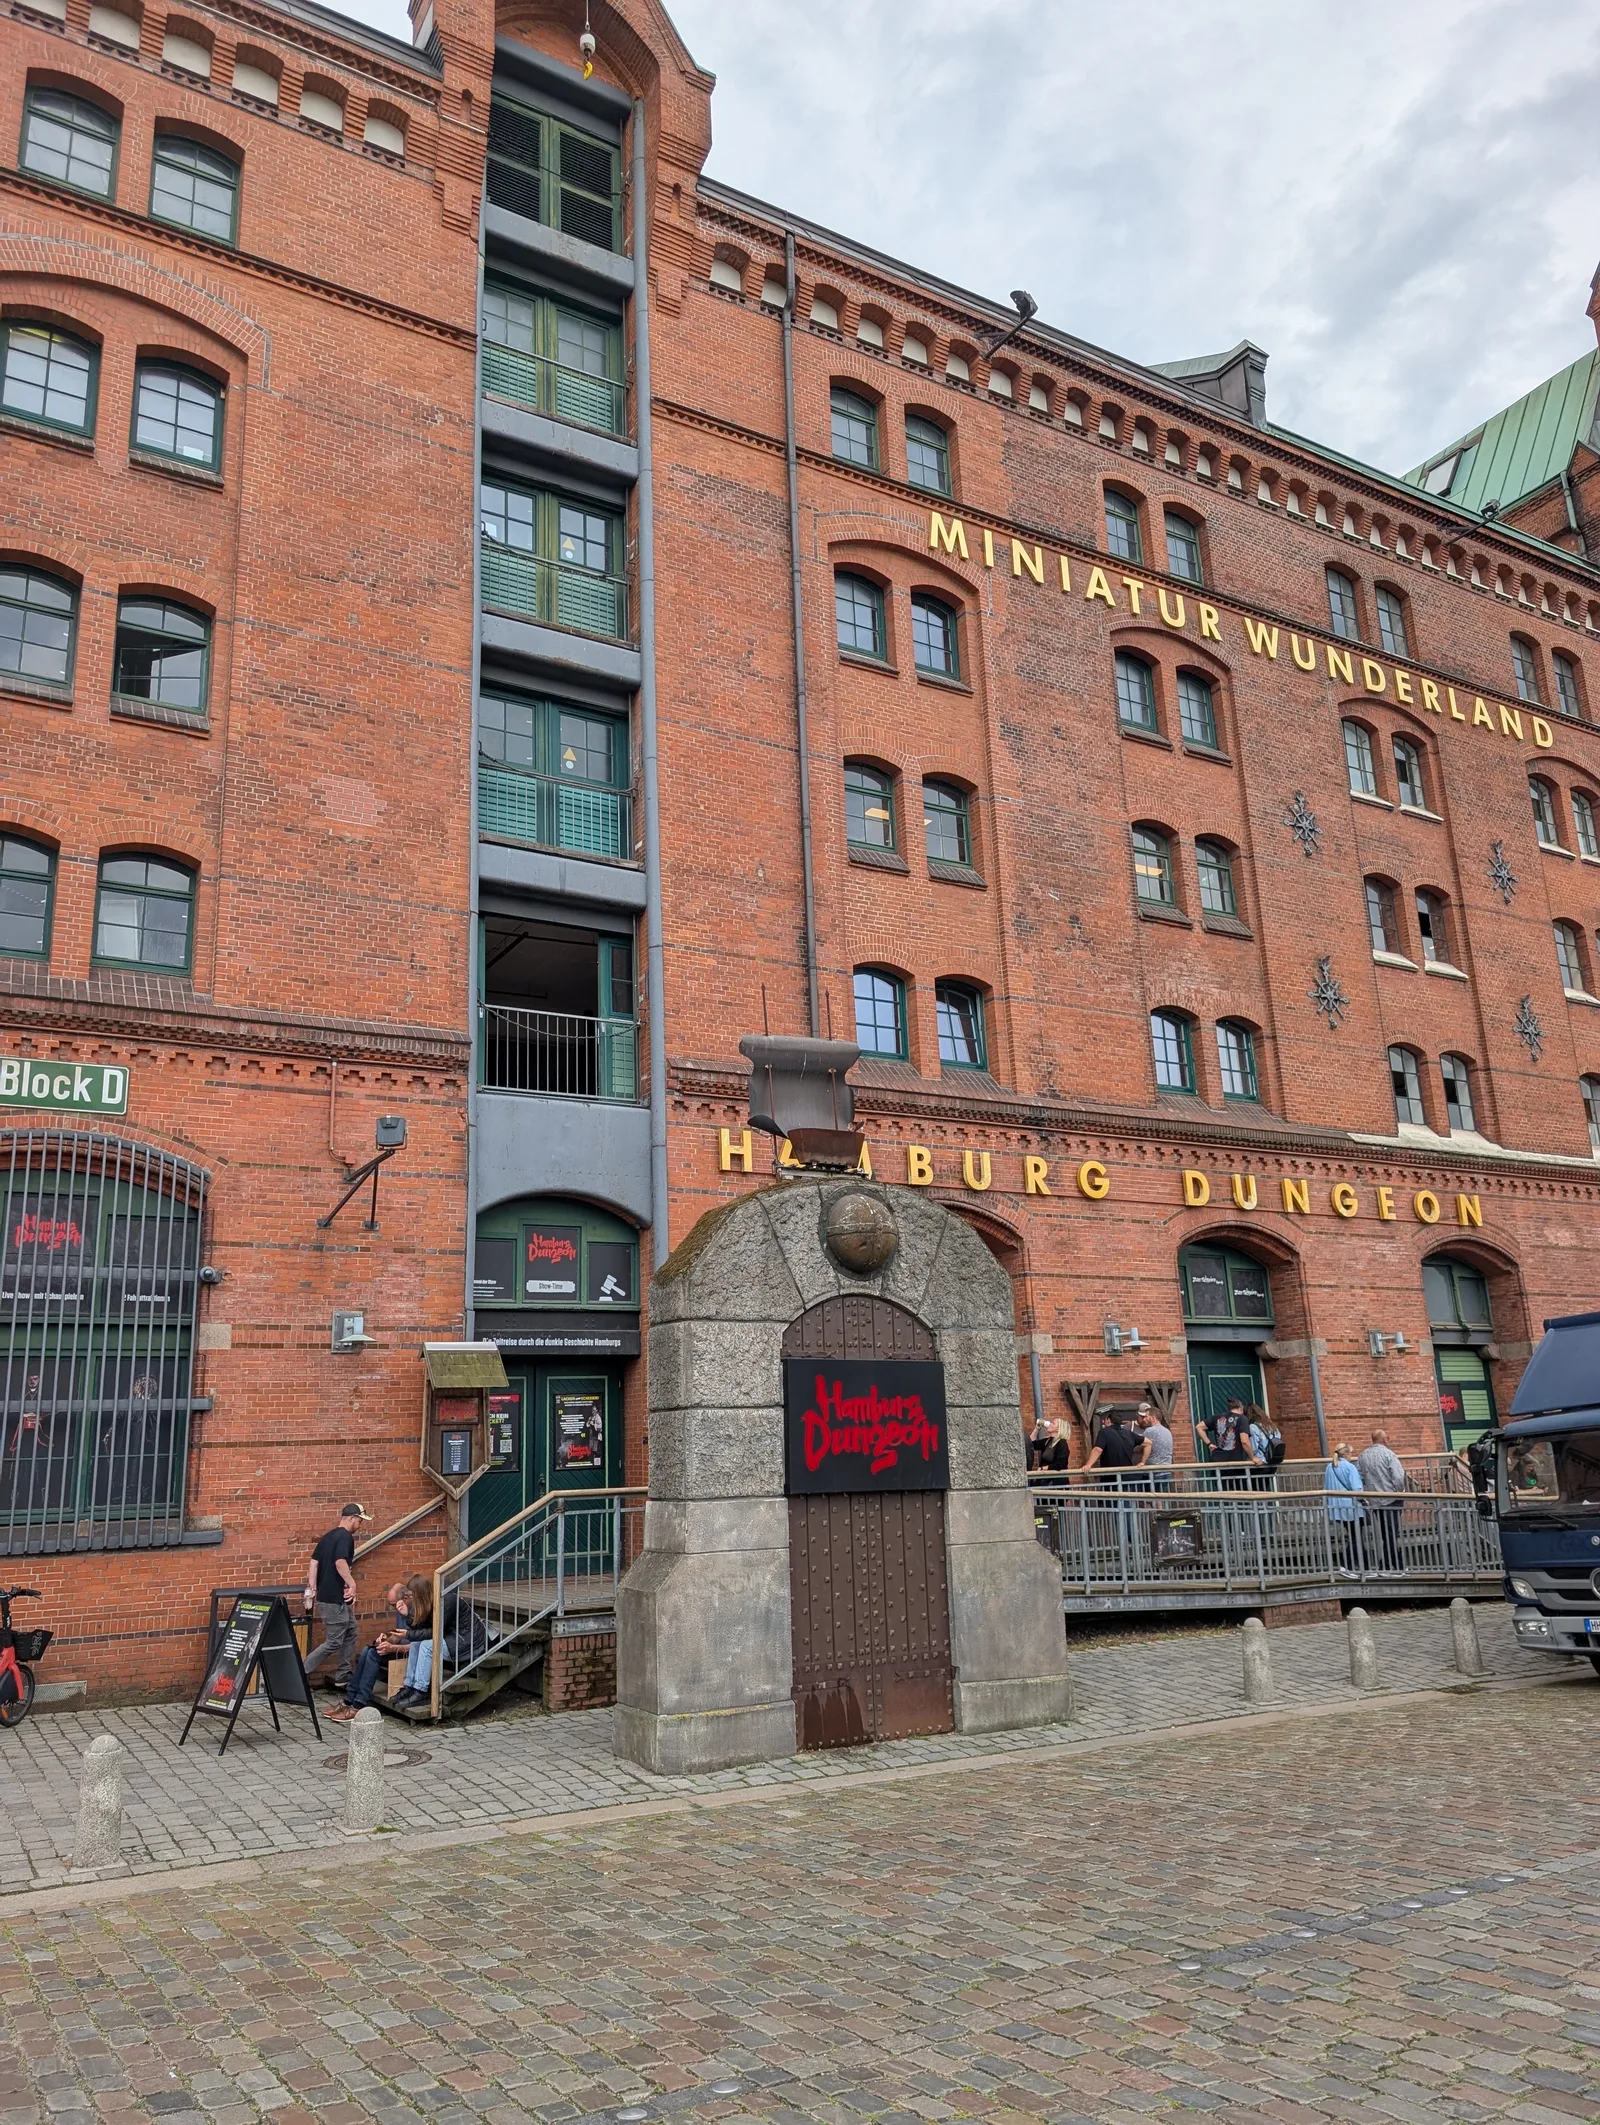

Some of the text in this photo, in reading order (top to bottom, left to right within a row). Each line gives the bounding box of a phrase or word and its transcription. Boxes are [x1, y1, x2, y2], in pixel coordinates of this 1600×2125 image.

[928, 511, 1555, 749] MINIATUR WUNDERLAND
[0, 1060, 124, 1104] Block D
[1182, 1168, 1483, 1227] DUNGEON
[527, 1243, 576, 1264] Dungeon
[532, 1232, 573, 1250] Hamburg
[538, 1282, 563, 1290] Show-Time
[518, 1337, 535, 1346] durch
[535, 1337, 545, 1346] die
[545, 1337, 563, 1346] dunkle
[564, 1337, 594, 1346] Geschichte
[595, 1337, 621, 1348] Hamburgs
[815, 1374, 927, 1425] Hamburg
[801, 1410, 940, 1475] Dungeon
